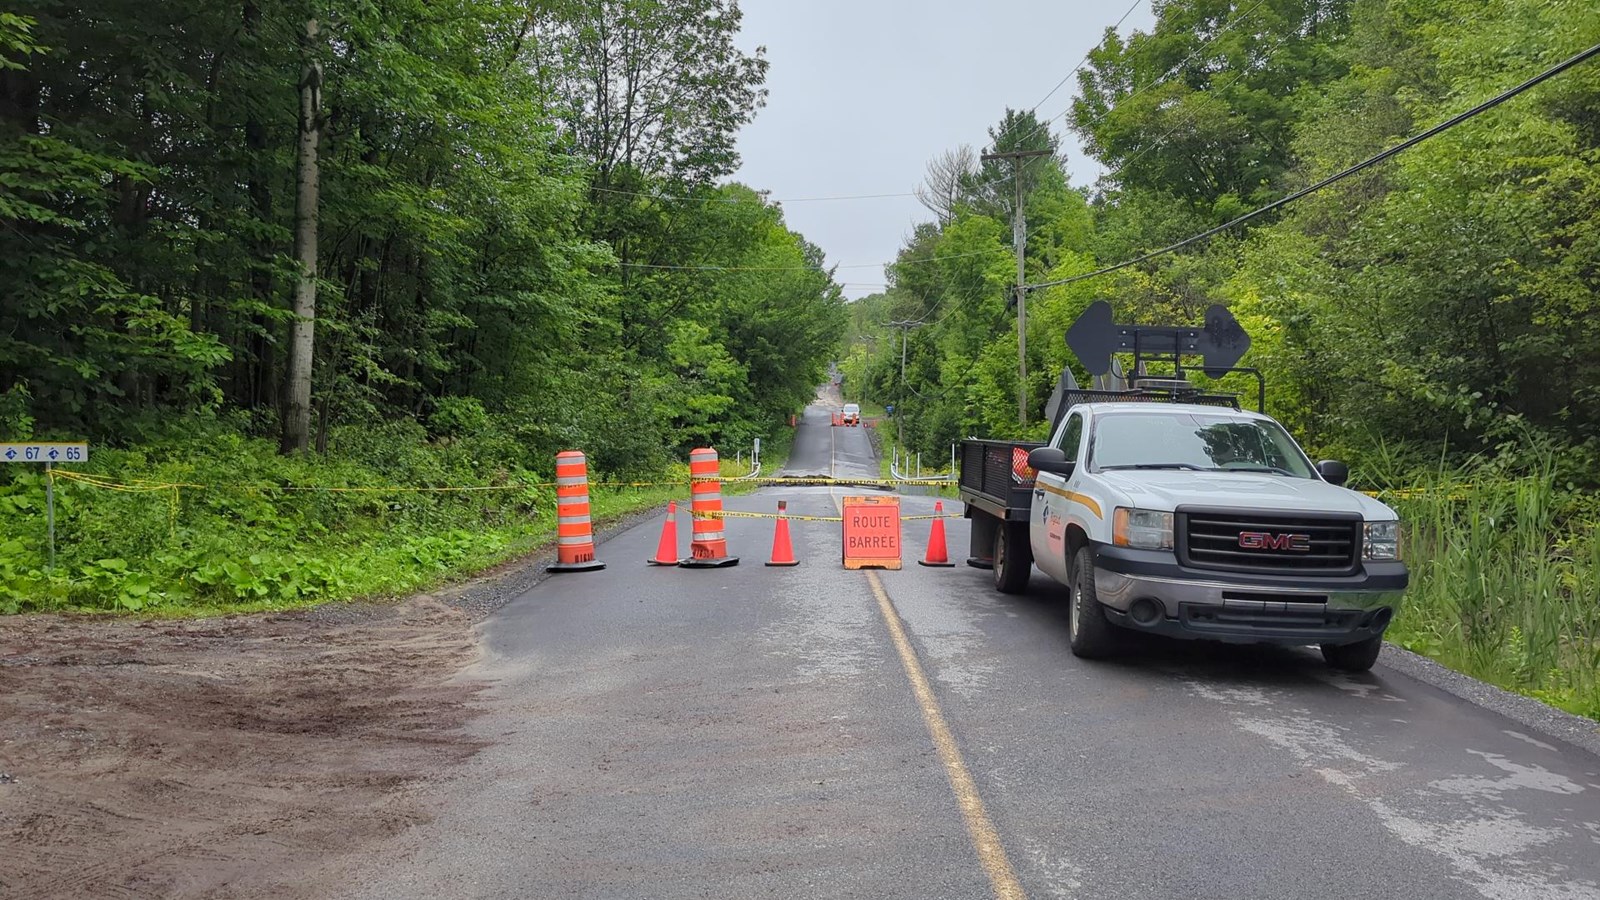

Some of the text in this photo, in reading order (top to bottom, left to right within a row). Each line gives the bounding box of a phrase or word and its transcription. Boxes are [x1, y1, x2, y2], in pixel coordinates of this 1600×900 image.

[25, 447, 81, 460] 67 65
[853, 516, 891, 528] ROUTE
[849, 534, 896, 548] BARRÉE
[1239, 531, 1310, 551] GMC
